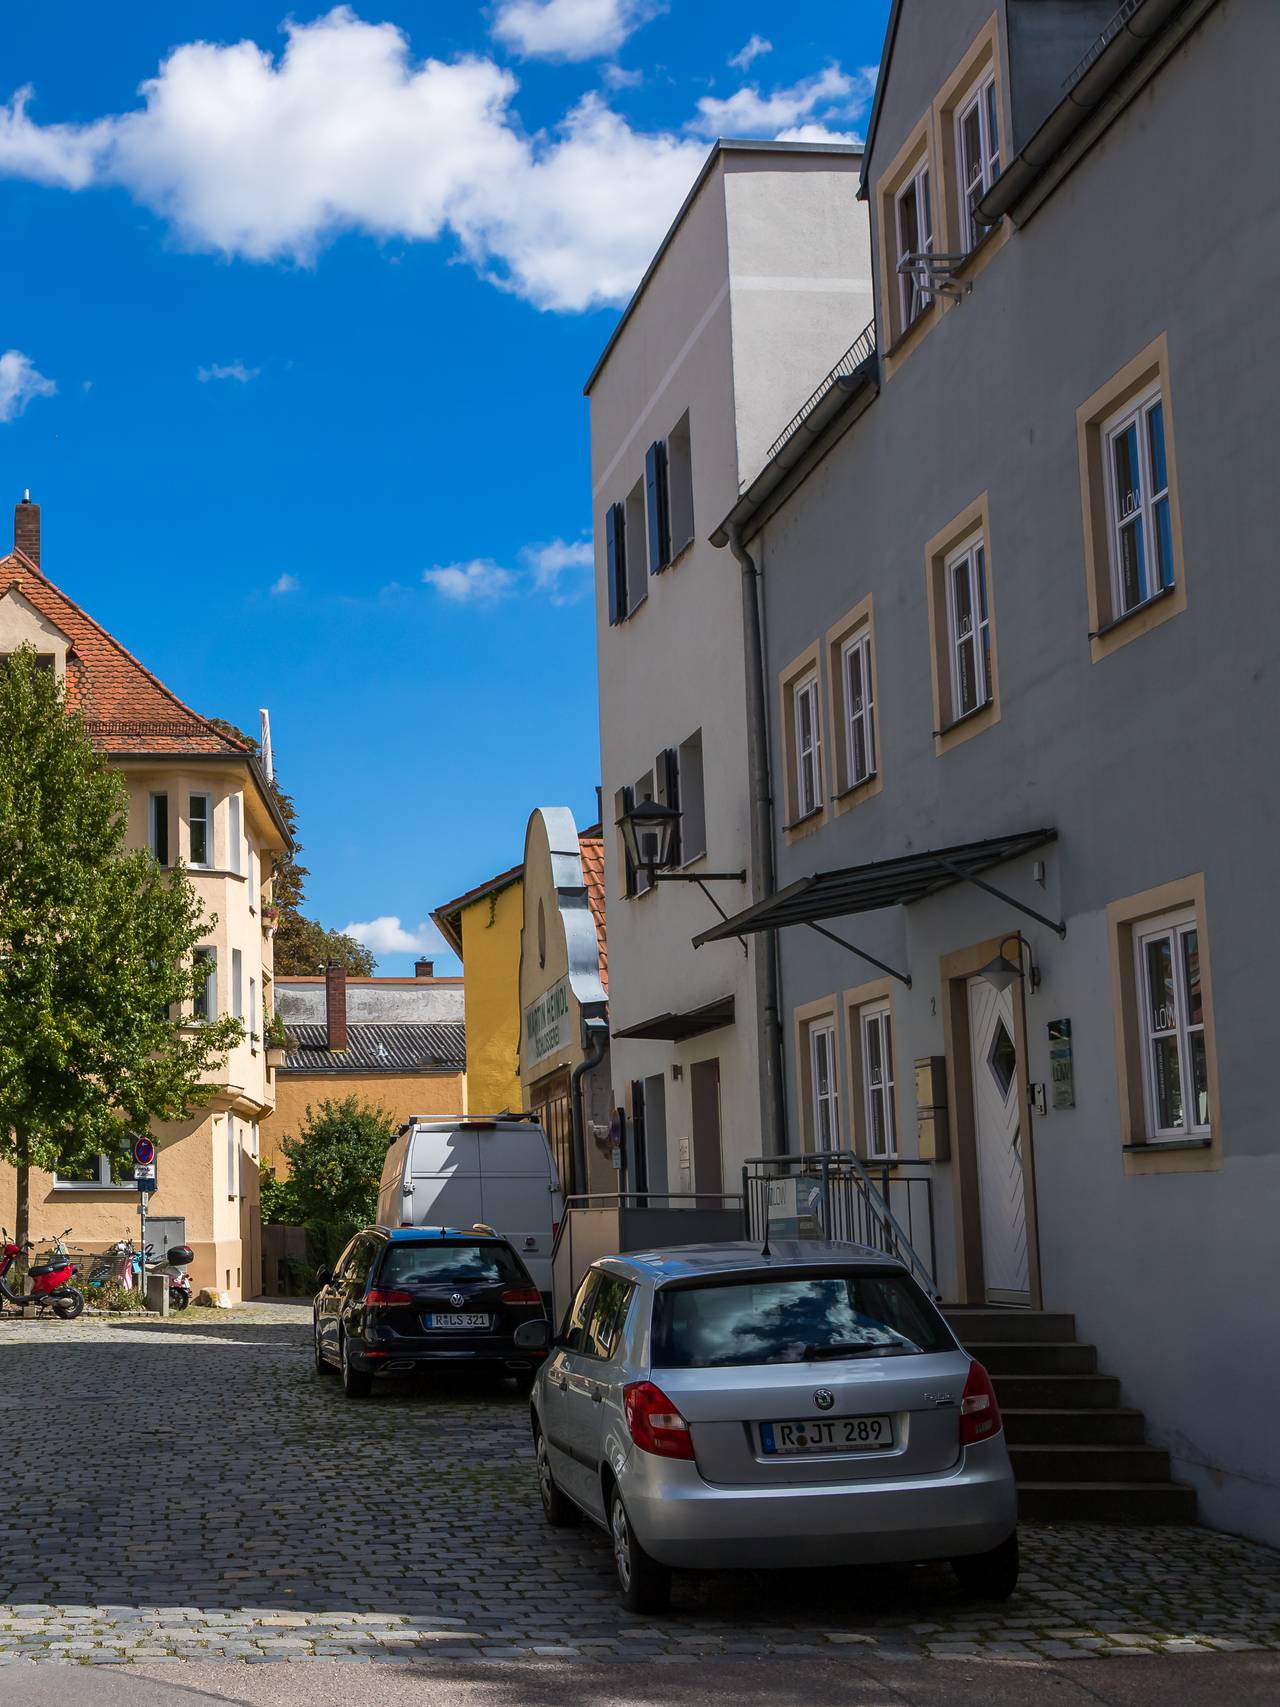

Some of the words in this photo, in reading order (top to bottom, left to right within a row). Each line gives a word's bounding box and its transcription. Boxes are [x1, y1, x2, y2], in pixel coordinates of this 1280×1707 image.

[449, 1315, 464, 1325] LS
[466, 1315, 486, 1325] 321
[780, 1425, 795, 1446] R
[810, 1423, 835, 1444] JT
[843, 1420, 883, 1442] 289
